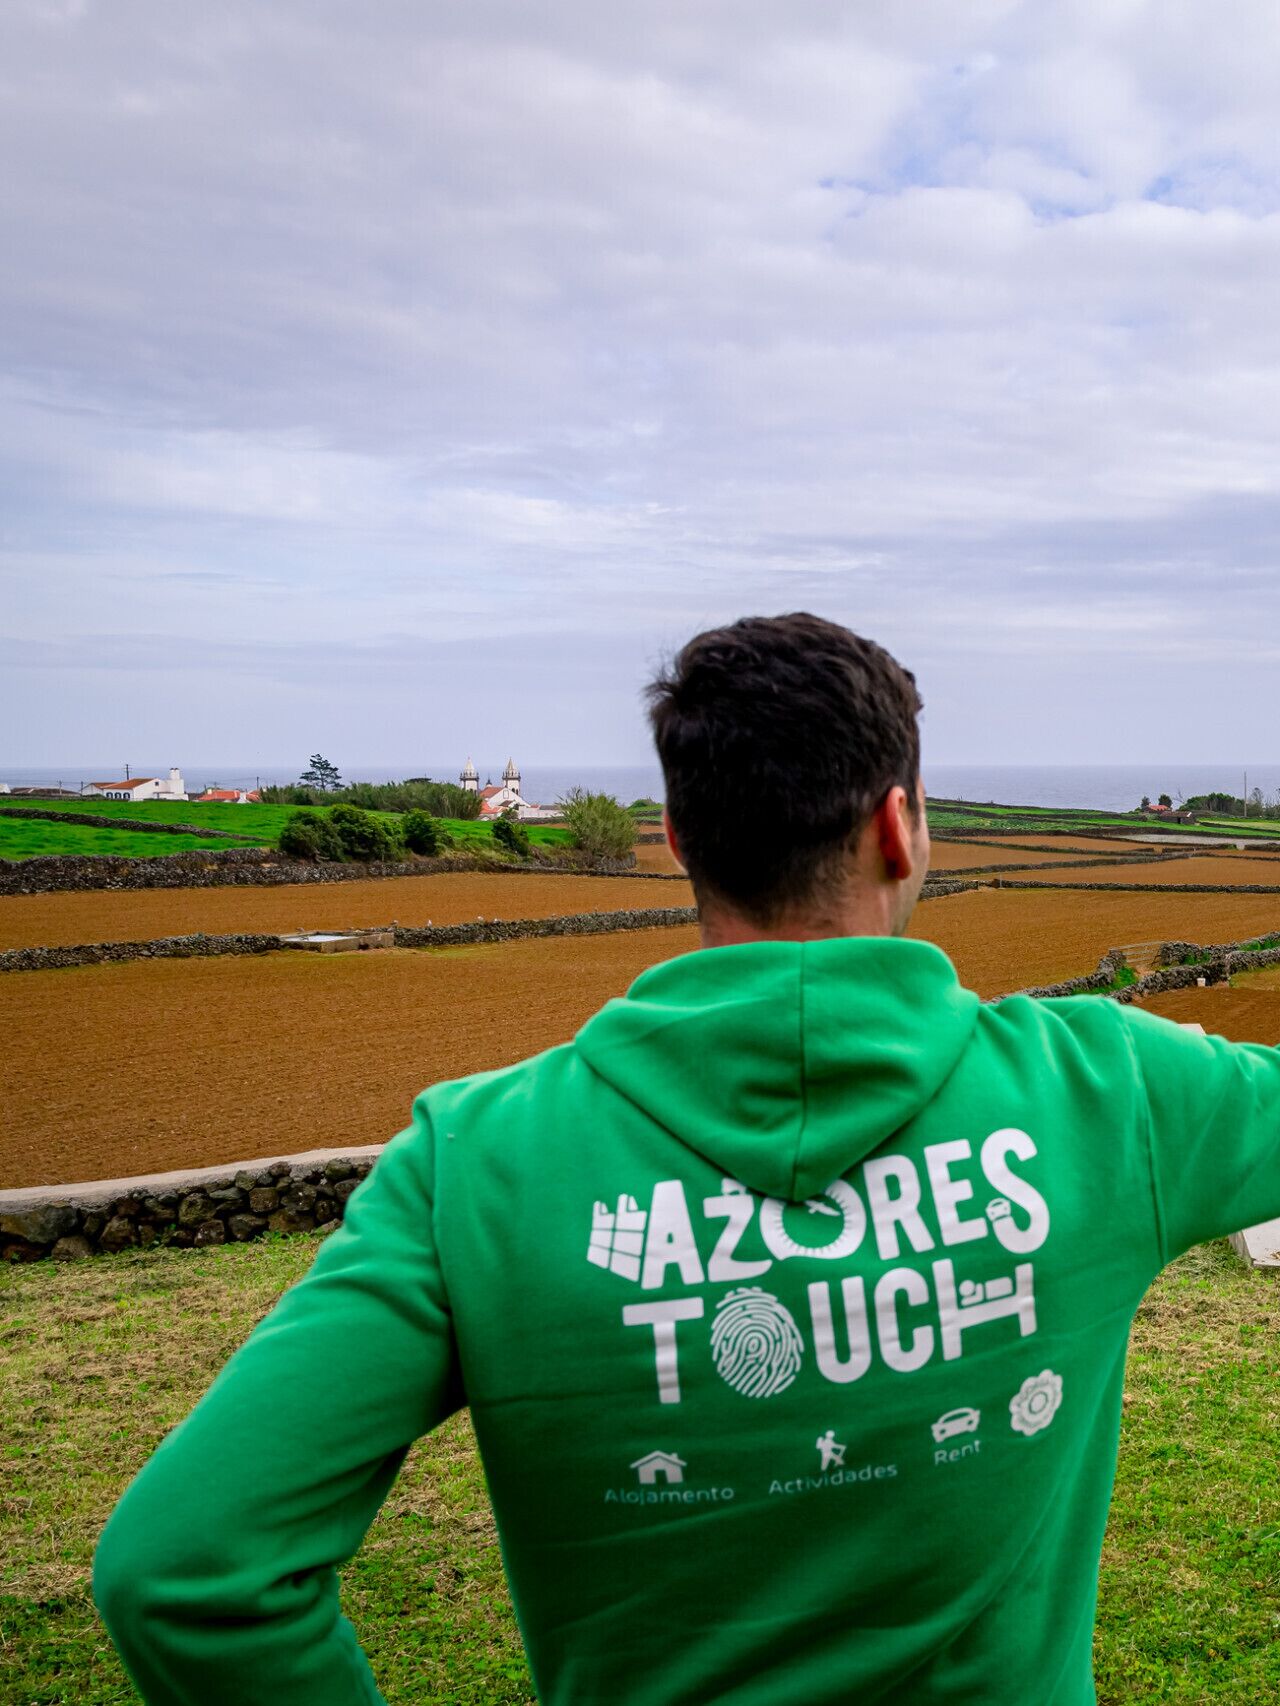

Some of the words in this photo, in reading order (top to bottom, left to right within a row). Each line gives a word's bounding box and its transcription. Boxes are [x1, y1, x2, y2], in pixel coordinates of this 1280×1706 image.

[641, 1128, 1049, 1289] AZORES
[622, 1258, 1037, 1404] TOUCH
[934, 1439, 981, 1466] Rent
[769, 1463, 897, 1496] Actividades
[605, 1487, 734, 1506] Alojamento
